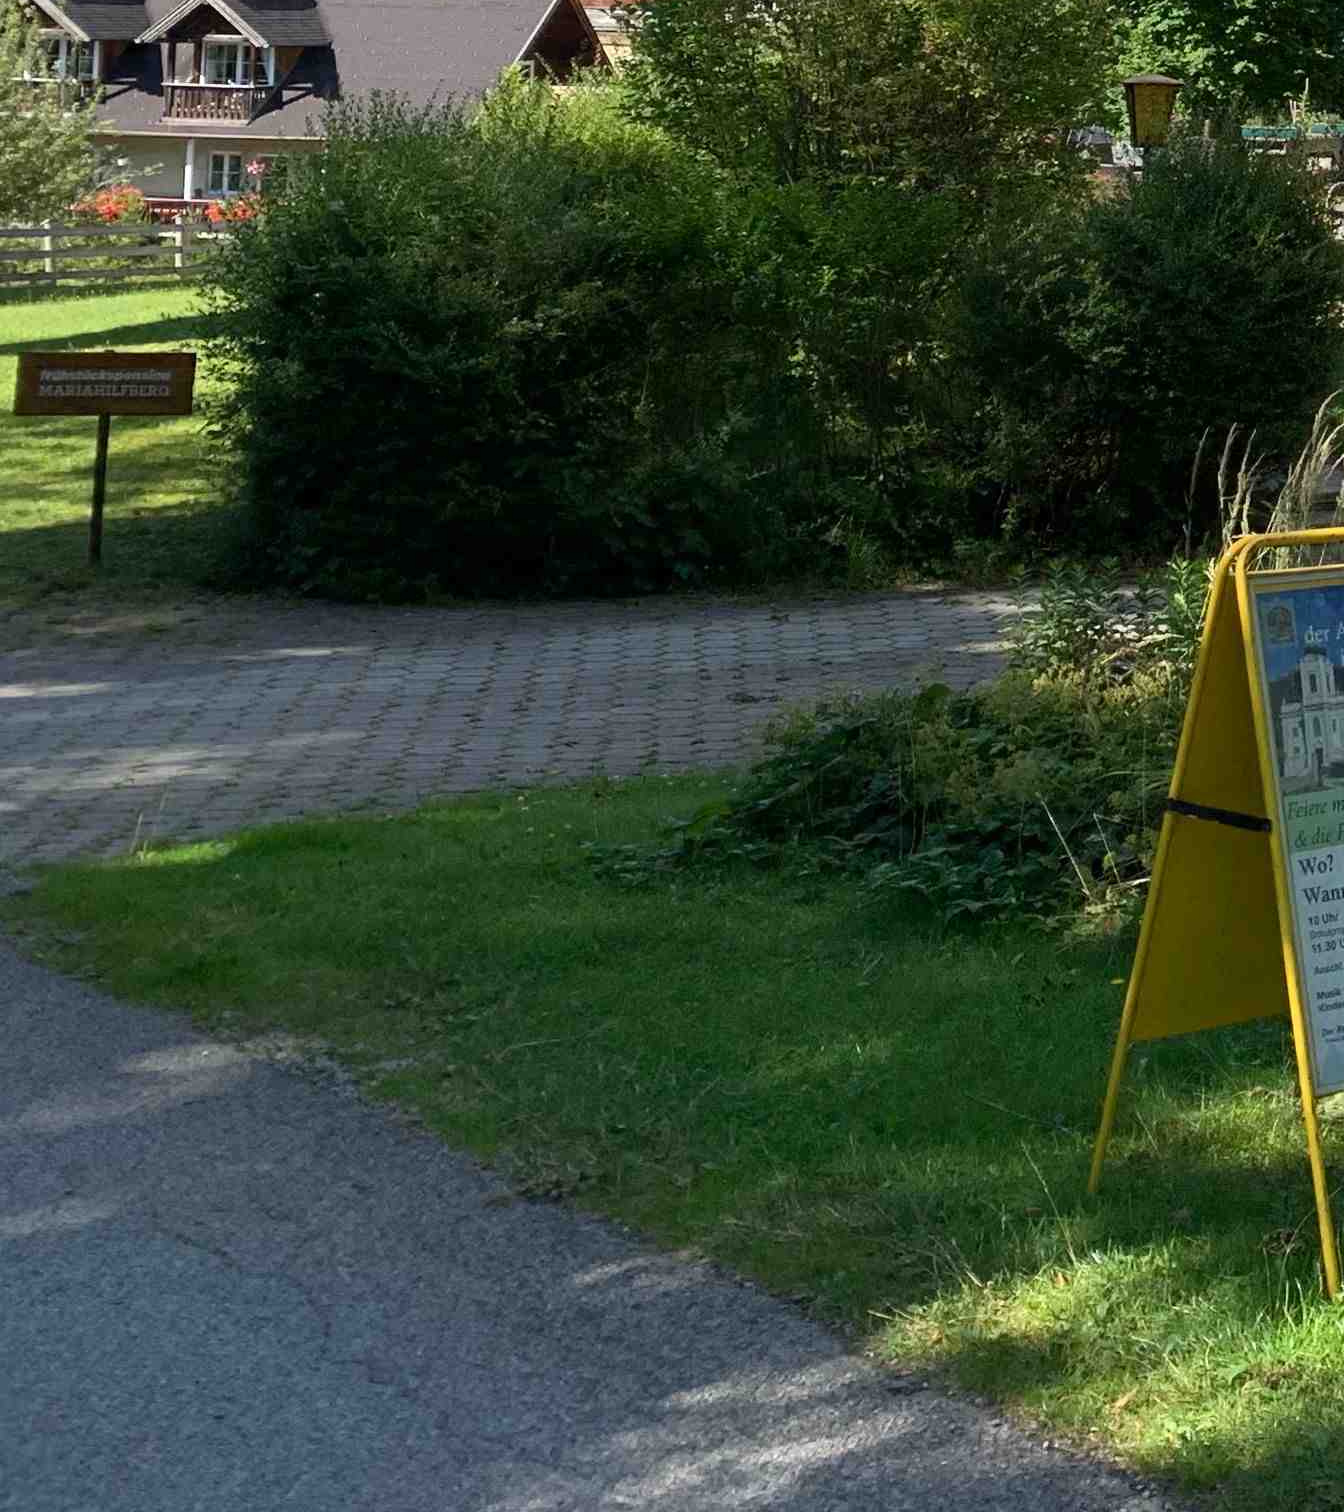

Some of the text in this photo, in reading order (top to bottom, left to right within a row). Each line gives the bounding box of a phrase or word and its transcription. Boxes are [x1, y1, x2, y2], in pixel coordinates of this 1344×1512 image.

[1304, 624, 1329, 643] der
[1288, 800, 1328, 820] Feiere
[1295, 829, 1307, 848] &
[1311, 824, 1329, 845] die
[1298, 854, 1334, 876] Wo?
